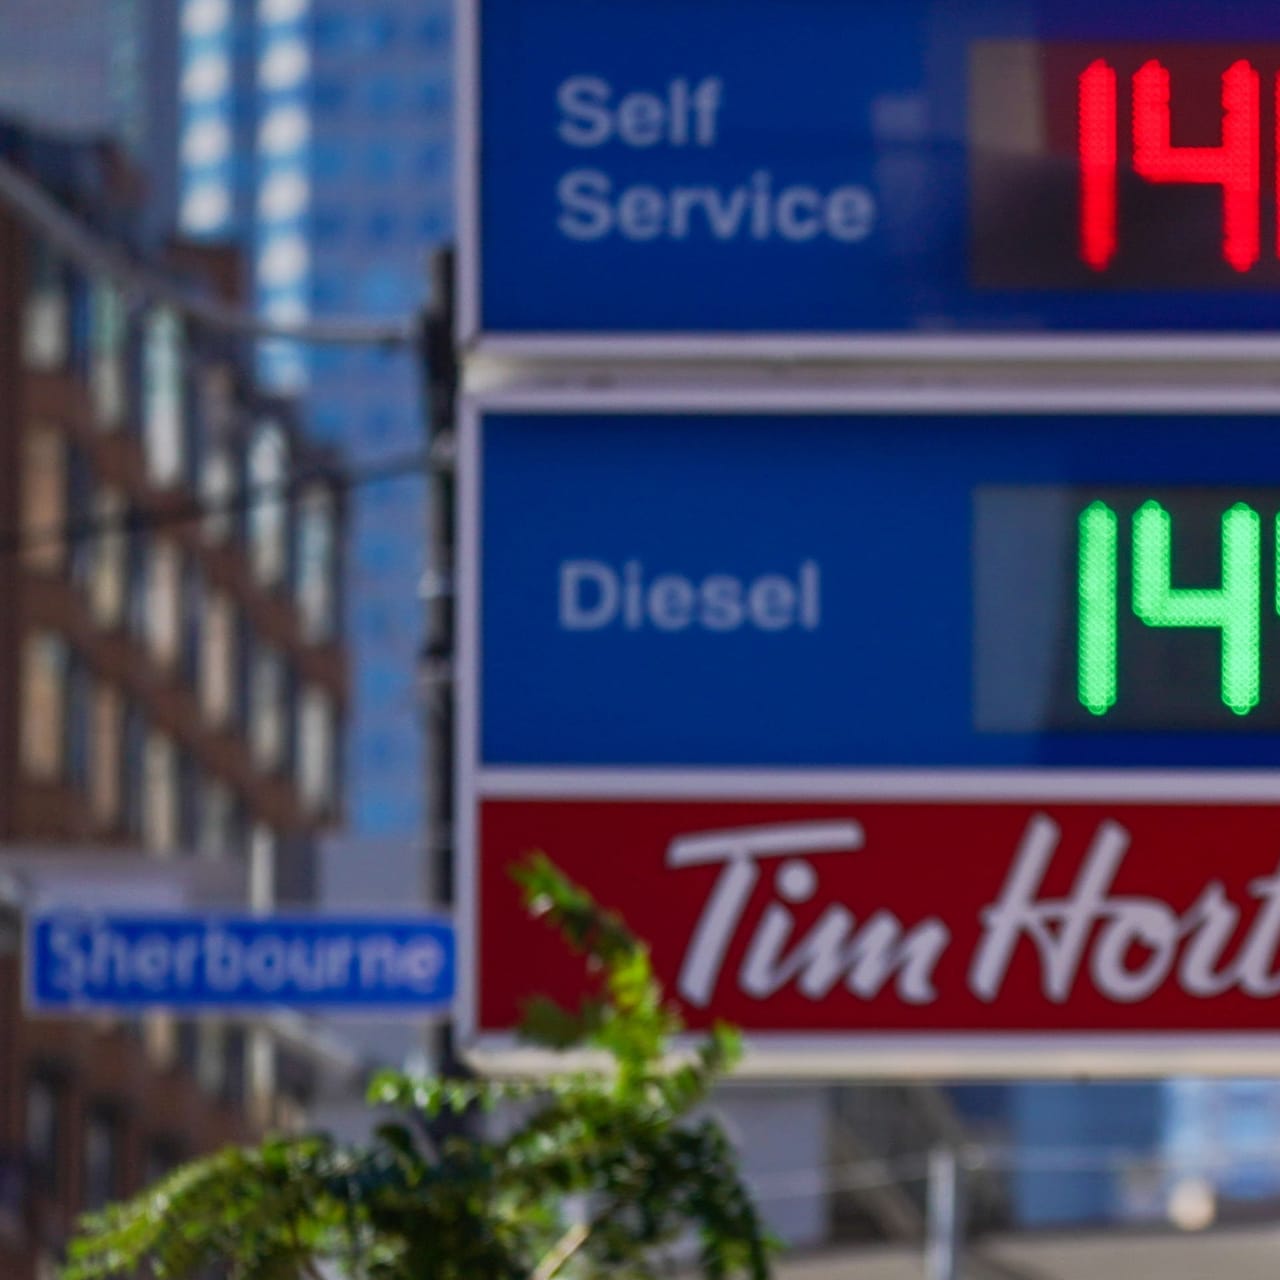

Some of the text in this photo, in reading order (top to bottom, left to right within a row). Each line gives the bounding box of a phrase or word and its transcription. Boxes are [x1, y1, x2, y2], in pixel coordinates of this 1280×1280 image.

[556, 74, 723, 147] Self
[556, 168, 876, 243] Service
[558, 561, 820, 634] Diesel
[665, 819, 950, 1007] Tim
[48, 920, 446, 996] Sherbourne
